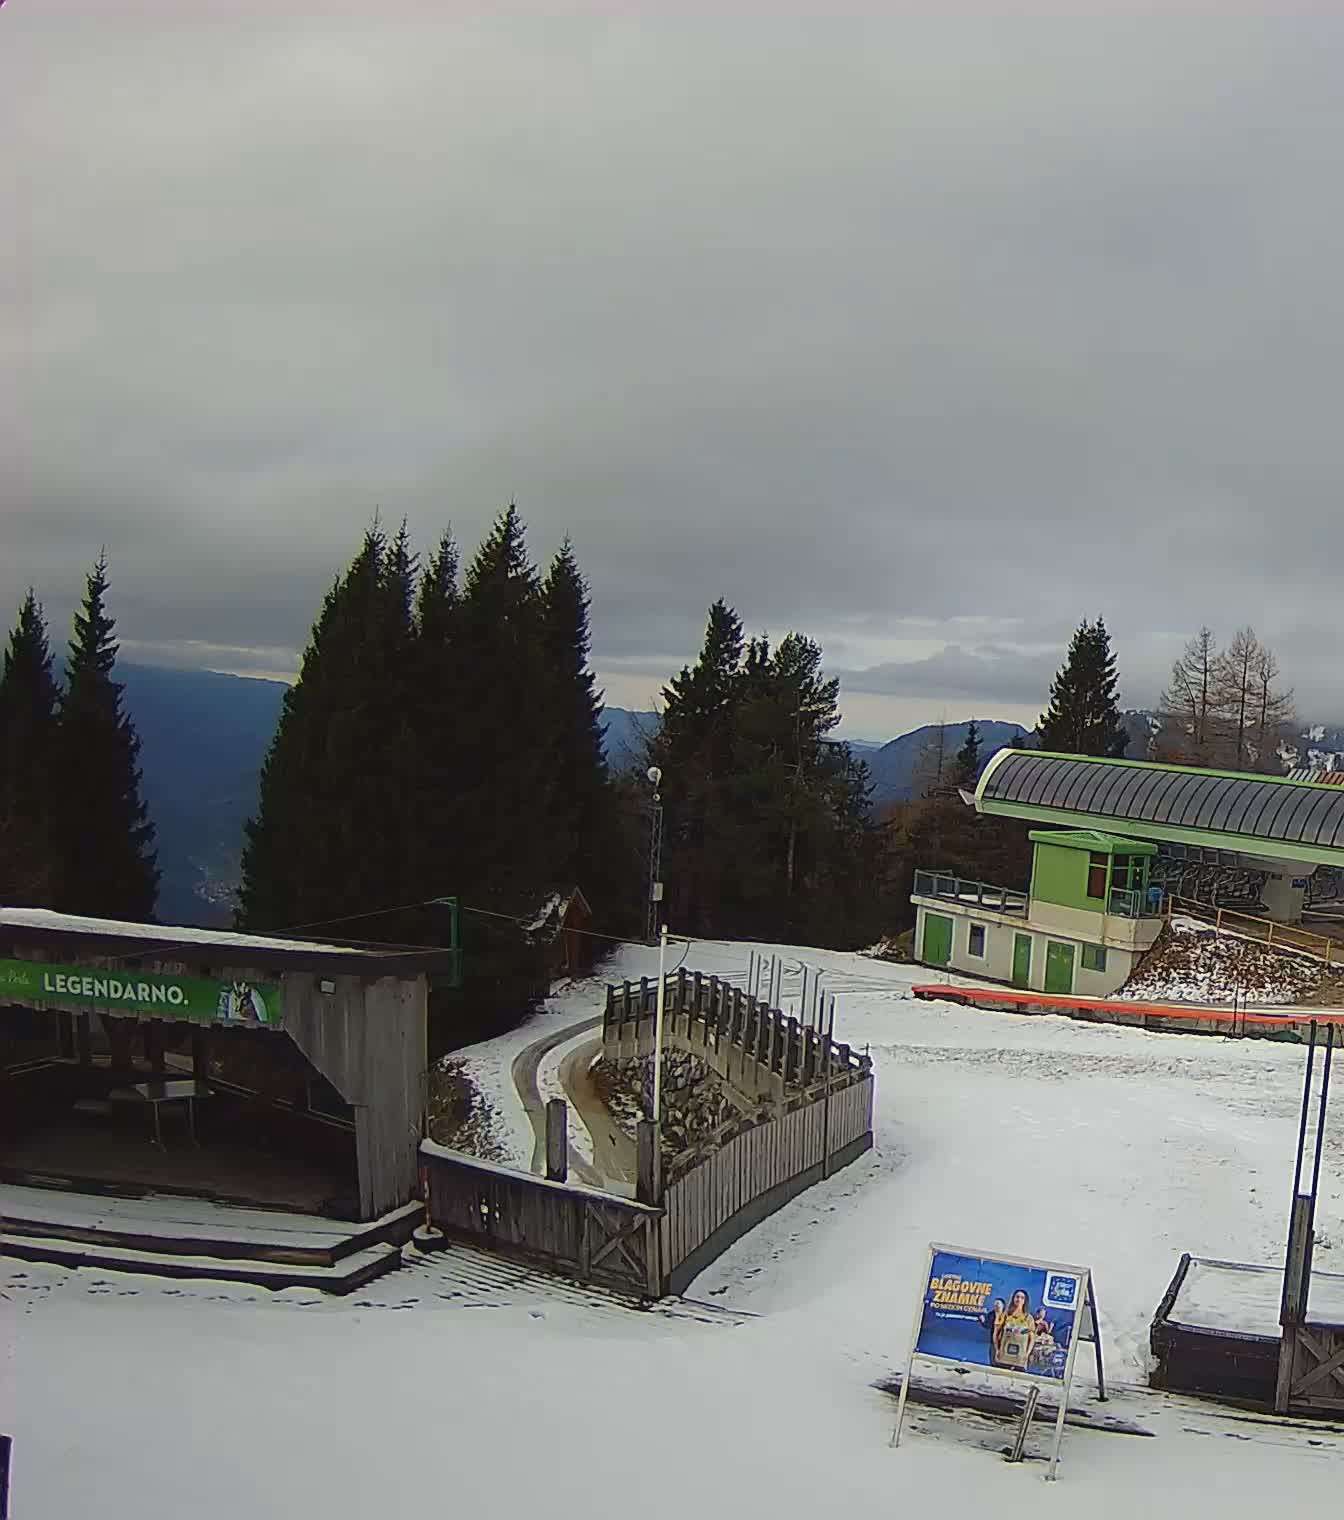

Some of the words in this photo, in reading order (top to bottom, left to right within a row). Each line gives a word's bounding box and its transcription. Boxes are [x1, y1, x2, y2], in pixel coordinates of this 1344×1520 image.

[43, 972, 189, 1005] LEGENDARNO.
[929, 1277, 993, 1296] BLAGOVNE
[933, 1290, 986, 1306] ZNAMKE
